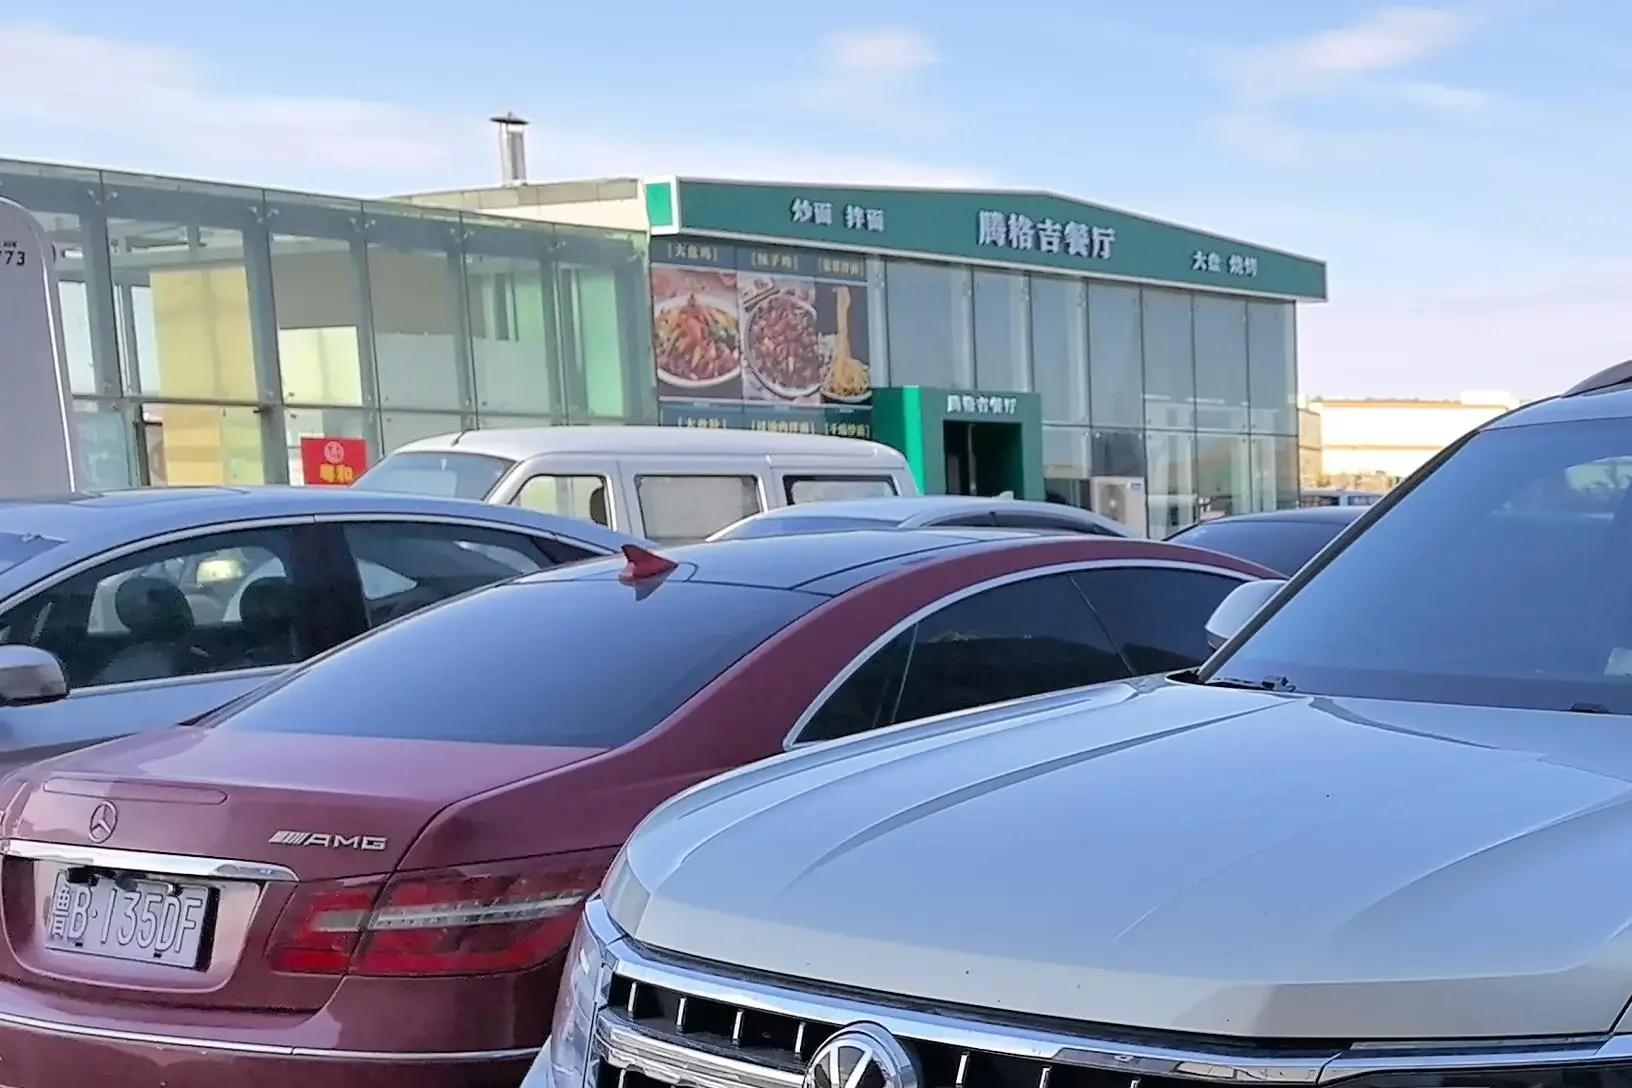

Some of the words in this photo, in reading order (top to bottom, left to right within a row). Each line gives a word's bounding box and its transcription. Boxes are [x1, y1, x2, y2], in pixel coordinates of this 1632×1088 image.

[791, 197, 833, 225] 炒面
[844, 204, 885, 232] 拌面
[977, 209, 1117, 261] 腾格吉餐厅
